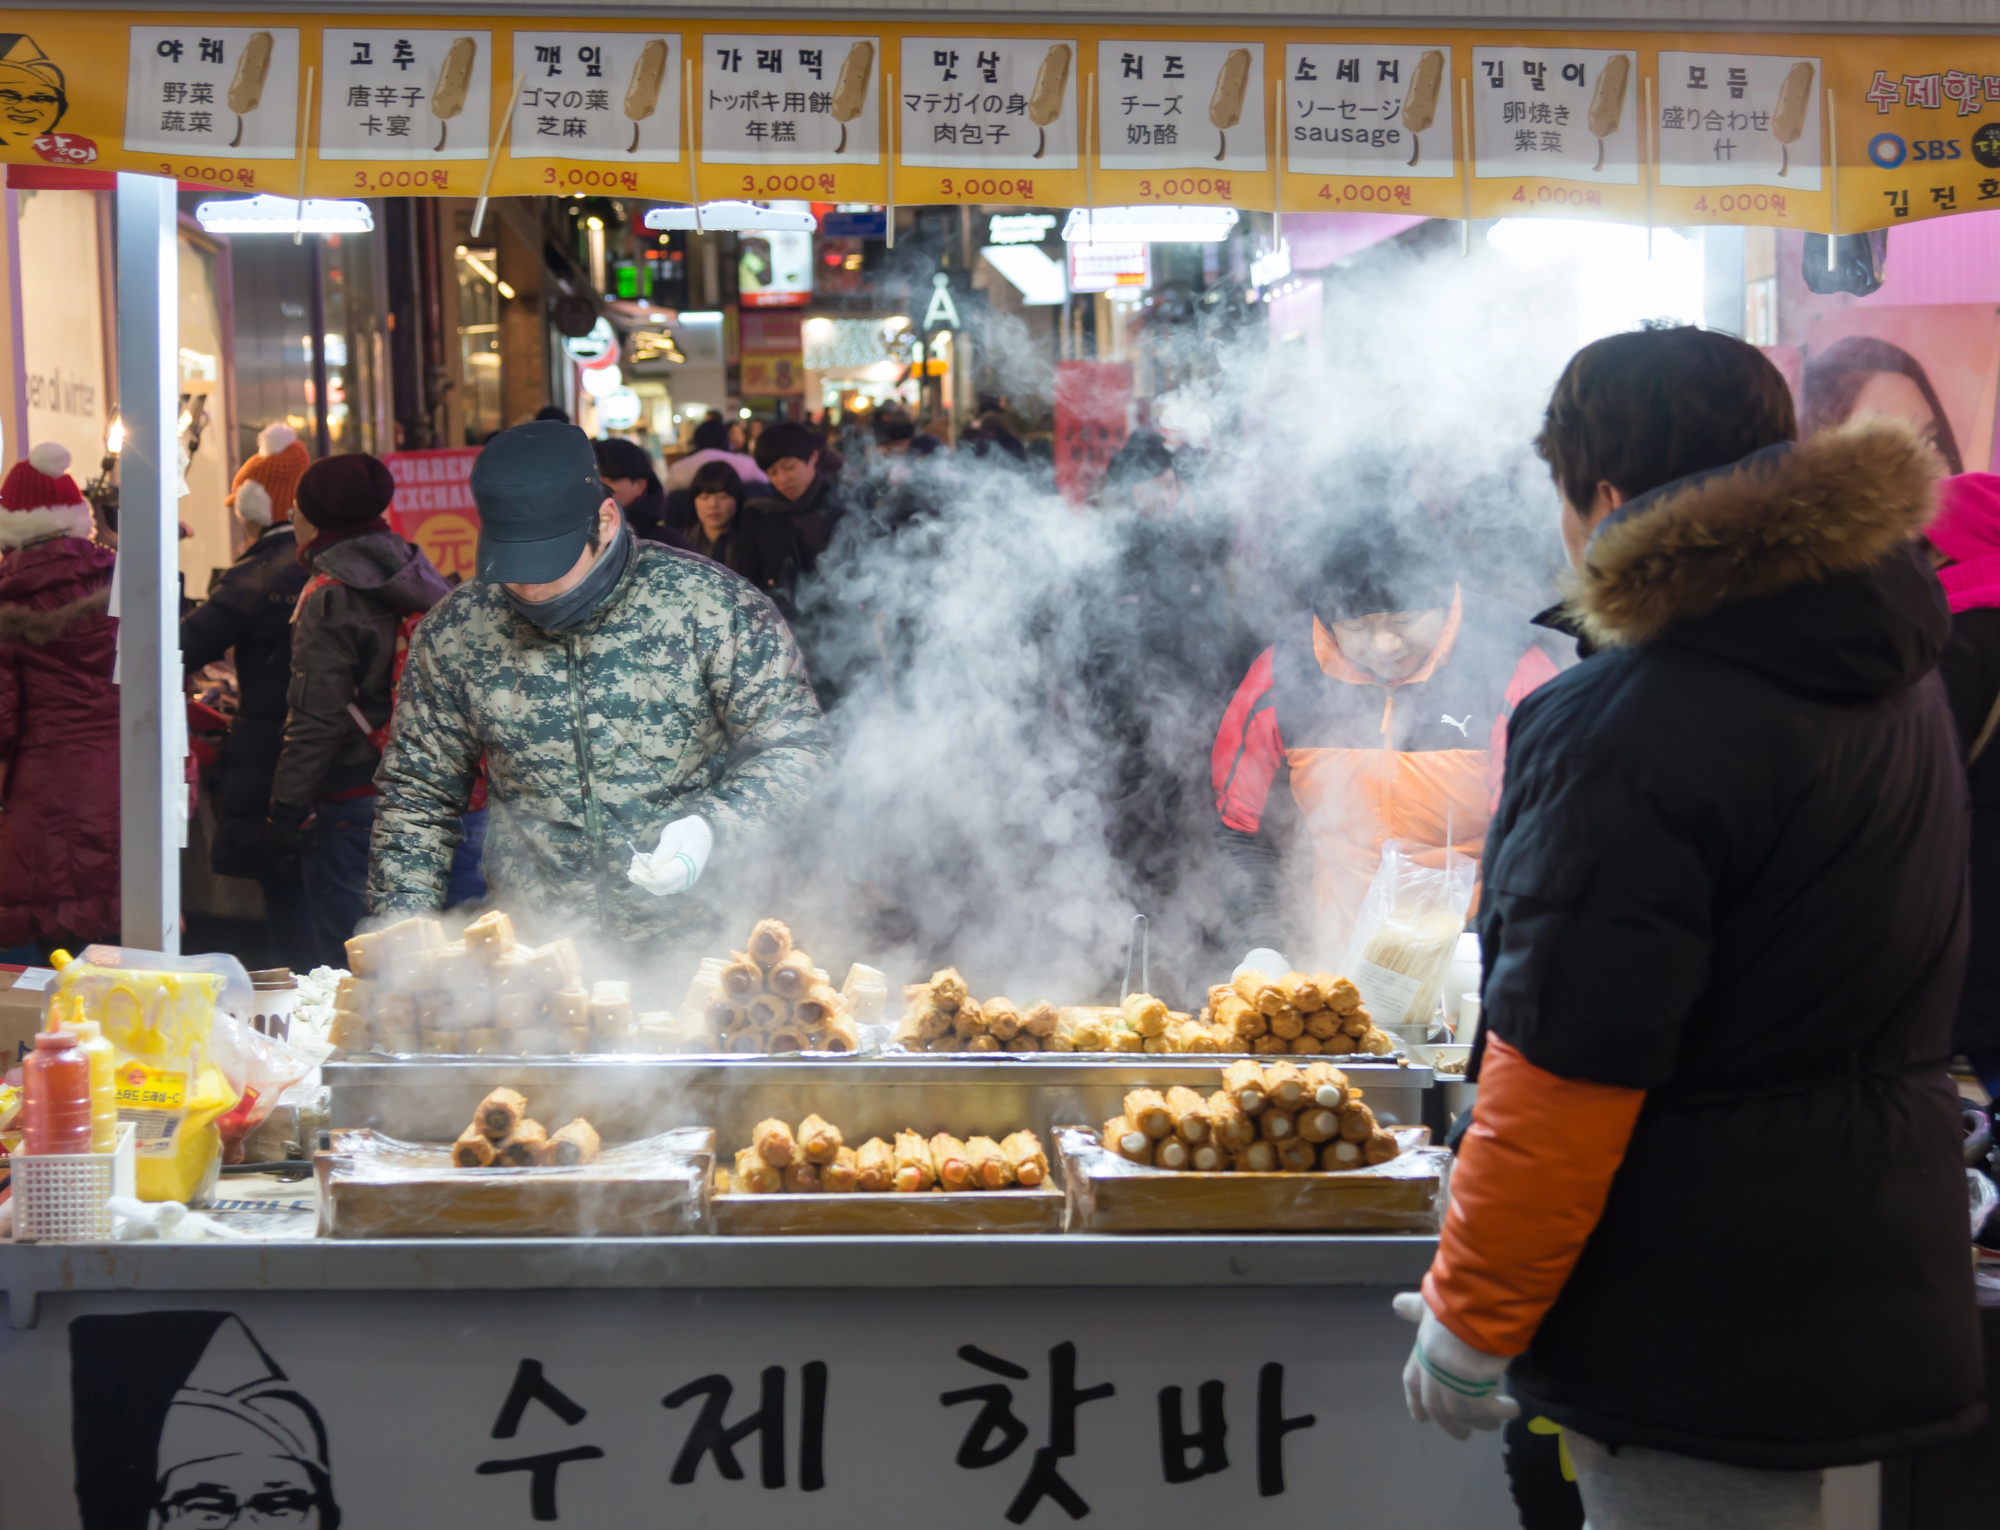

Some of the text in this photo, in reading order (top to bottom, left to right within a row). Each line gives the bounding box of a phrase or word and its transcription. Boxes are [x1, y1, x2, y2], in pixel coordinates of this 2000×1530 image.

[156, 38, 224, 64] 야채
[350, 39, 416, 71] 고추
[534, 45, 603, 78] 깻잎
[716, 48, 824, 81] 가래떡
[932, 50, 1001, 84] 맛살
[1120, 53, 1186, 81] 치즈
[1294, 57, 1400, 84] 소세지
[1480, 60, 1586, 92] 김말이
[162, 81, 214, 105] 野菜
[1686, 65, 1749, 99] 모듬
[346, 84, 426, 109] 唐辛子
[521, 87, 610, 112] ゴマの葉
[708, 89, 833, 116] トッポキ用餅
[902, 93, 1029, 117] マテガイの身
[1120, 95, 1184, 117] チーズ
[160, 110, 214, 133] 蔬菜
[1296, 98, 1402, 122] ソーセージ
[1501, 101, 1571, 127] 卵焼き
[1661, 105, 1771, 132] 盛り合わせ
[359, 114, 412, 137] 卡宴
[536, 116, 588, 139] 芝麻
[744, 119, 797, 144] 年糕
[934, 123, 1011, 146] 肉包子
[1126, 122, 1179, 146] 奶酪
[1293, 125, 1401, 149] sausage
[1513, 129, 1564, 154] 紫菜
[1712, 137, 1738, 161] 什
[1911, 139, 1962, 161] SBS
[158, 162, 256, 188] 3,000원
[354, 169, 450, 193] 3,000원
[543, 167, 639, 193] 3,000원
[741, 173, 837, 196] 3,000원
[939, 178, 1035, 201] 3,000원
[1138, 178, 1233, 202] 3,000원
[1317, 183, 1413, 207] 4,000원
[1511, 184, 1602, 211] 4,000원
[1694, 193, 1788, 218] 4,000원
[425, 528, 474, 570] 元
